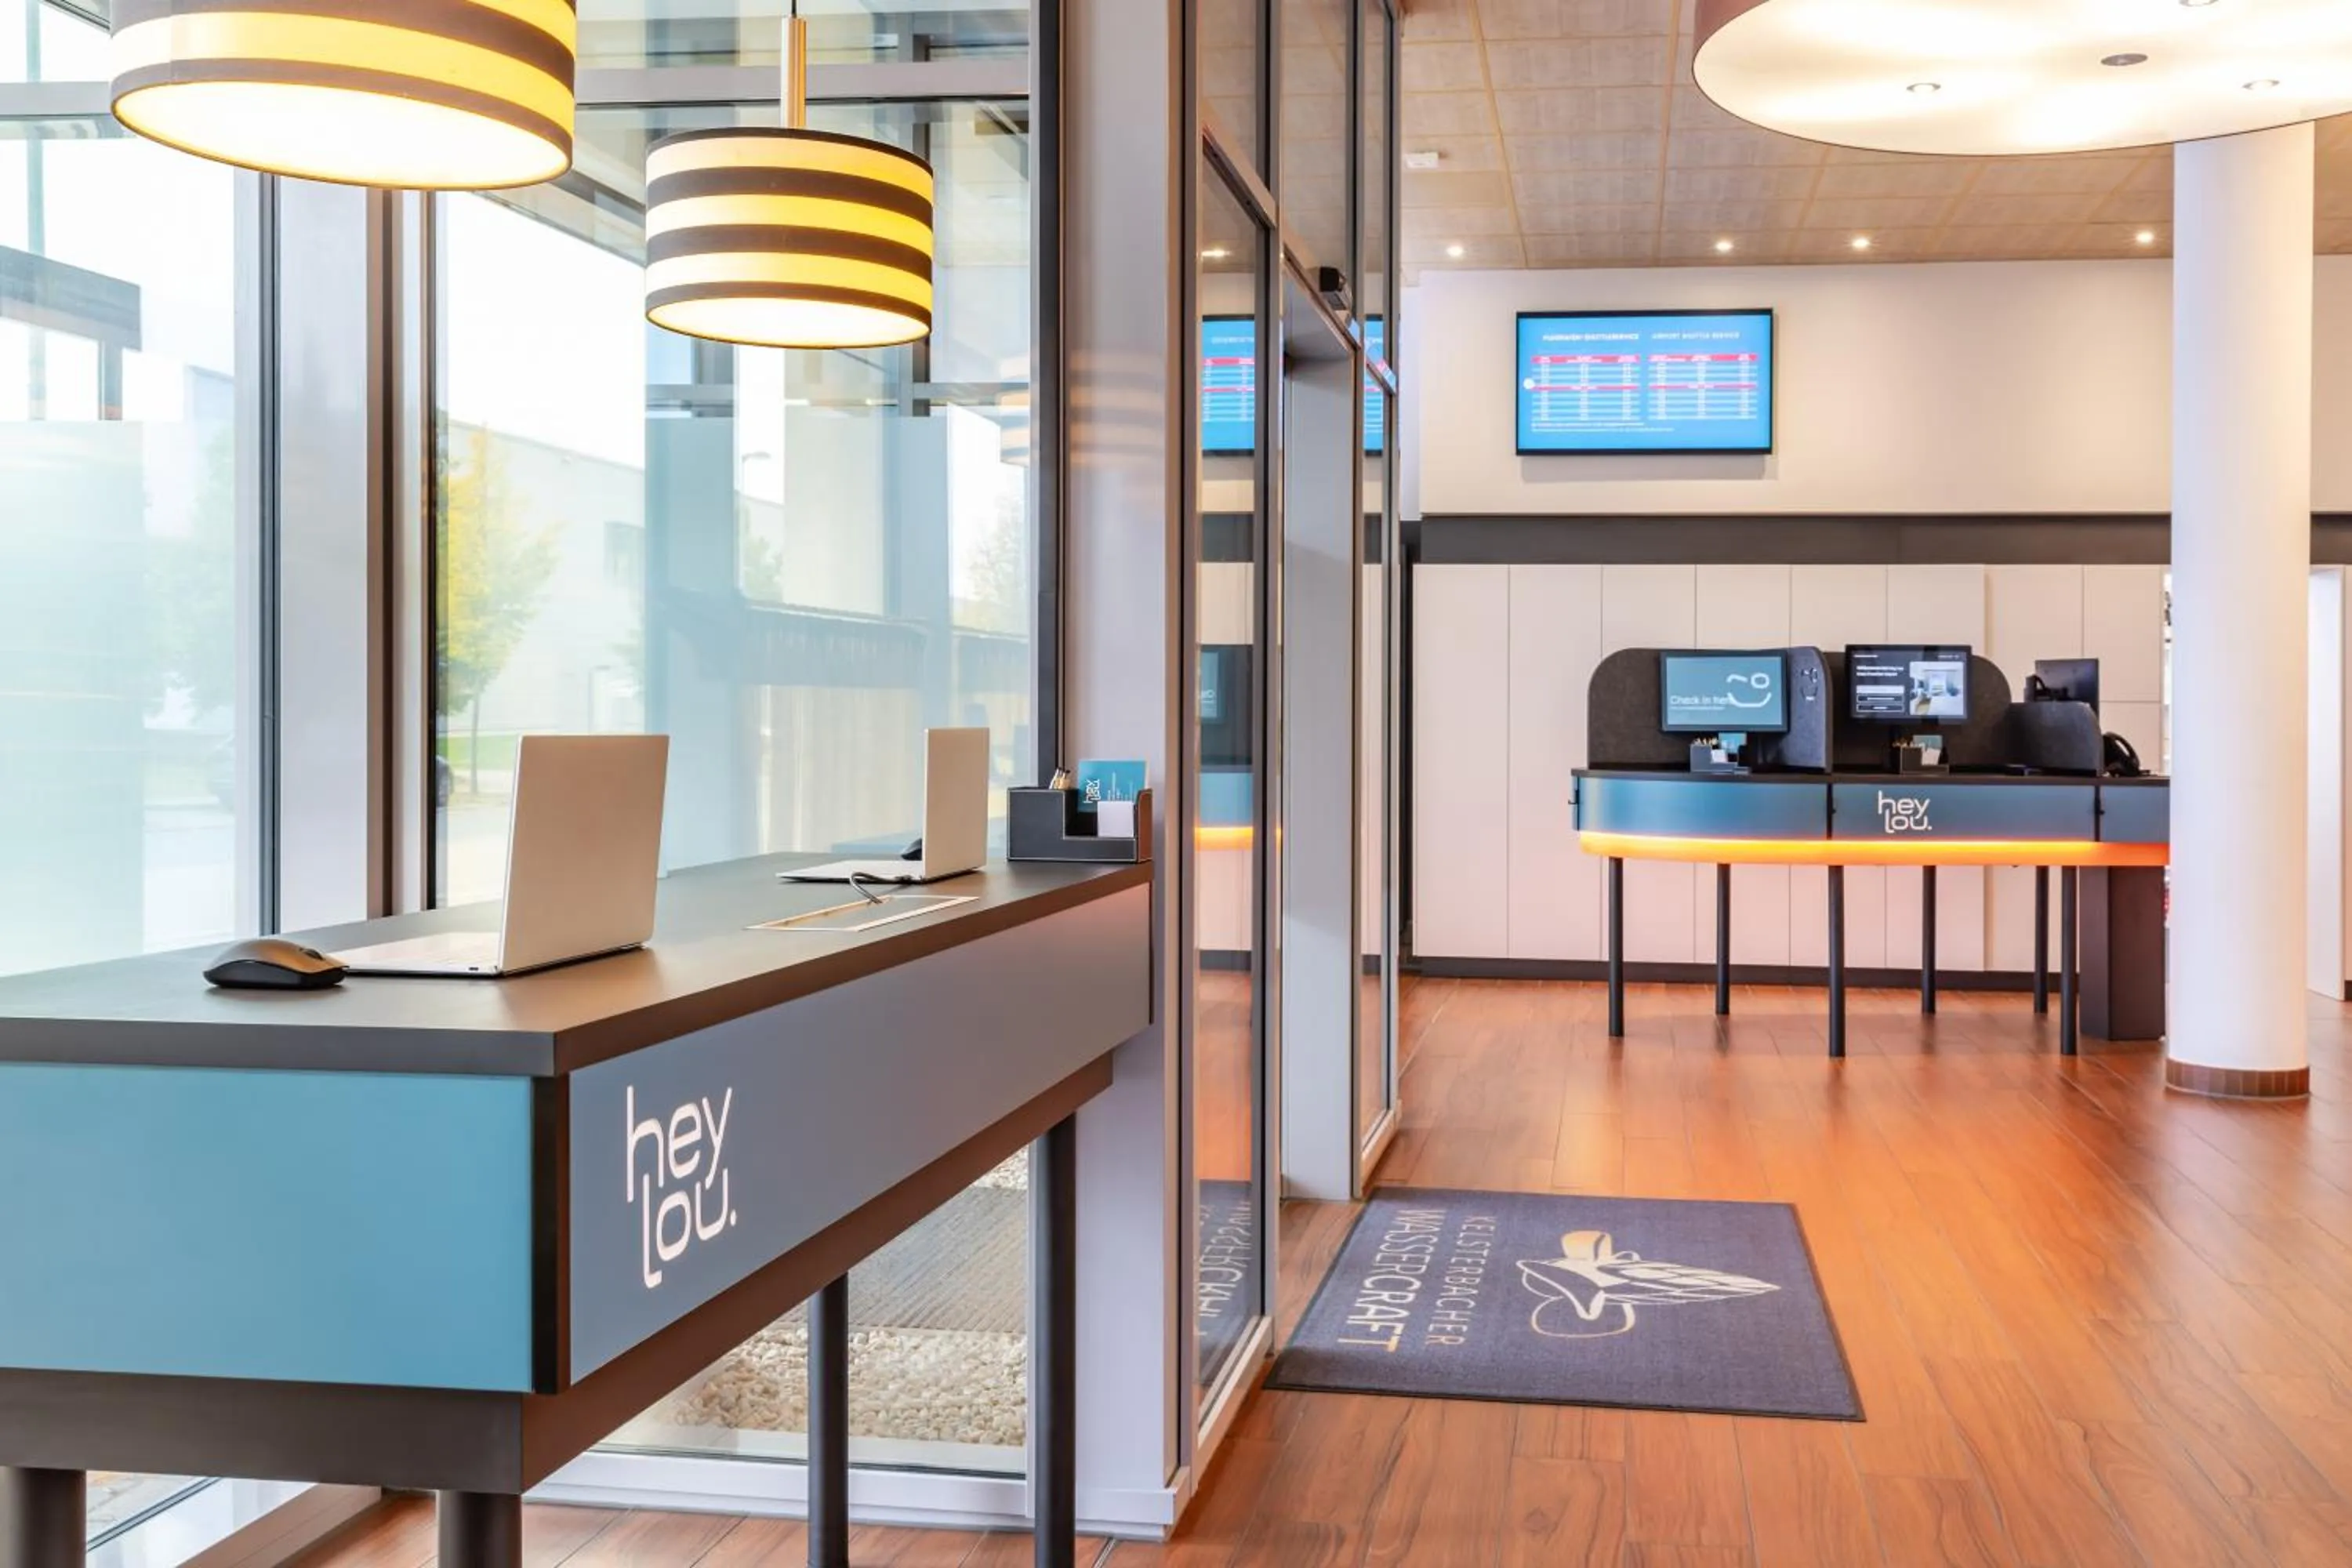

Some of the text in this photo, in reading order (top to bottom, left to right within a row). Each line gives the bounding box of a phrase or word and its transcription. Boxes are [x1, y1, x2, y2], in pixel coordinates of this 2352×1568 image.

[1670, 695, 1699, 705] Check
[1701, 695, 1711, 704] in
[1878, 789, 1931, 819] hey
[1885, 808, 1933, 833] lou.
[626, 1085, 733, 1203] hey
[642, 1167, 737, 1289] lou.
[1337, 1209, 1446, 1353] WASSERCRAFT
[1425, 1216, 1497, 1345] KELSTERBACHER
